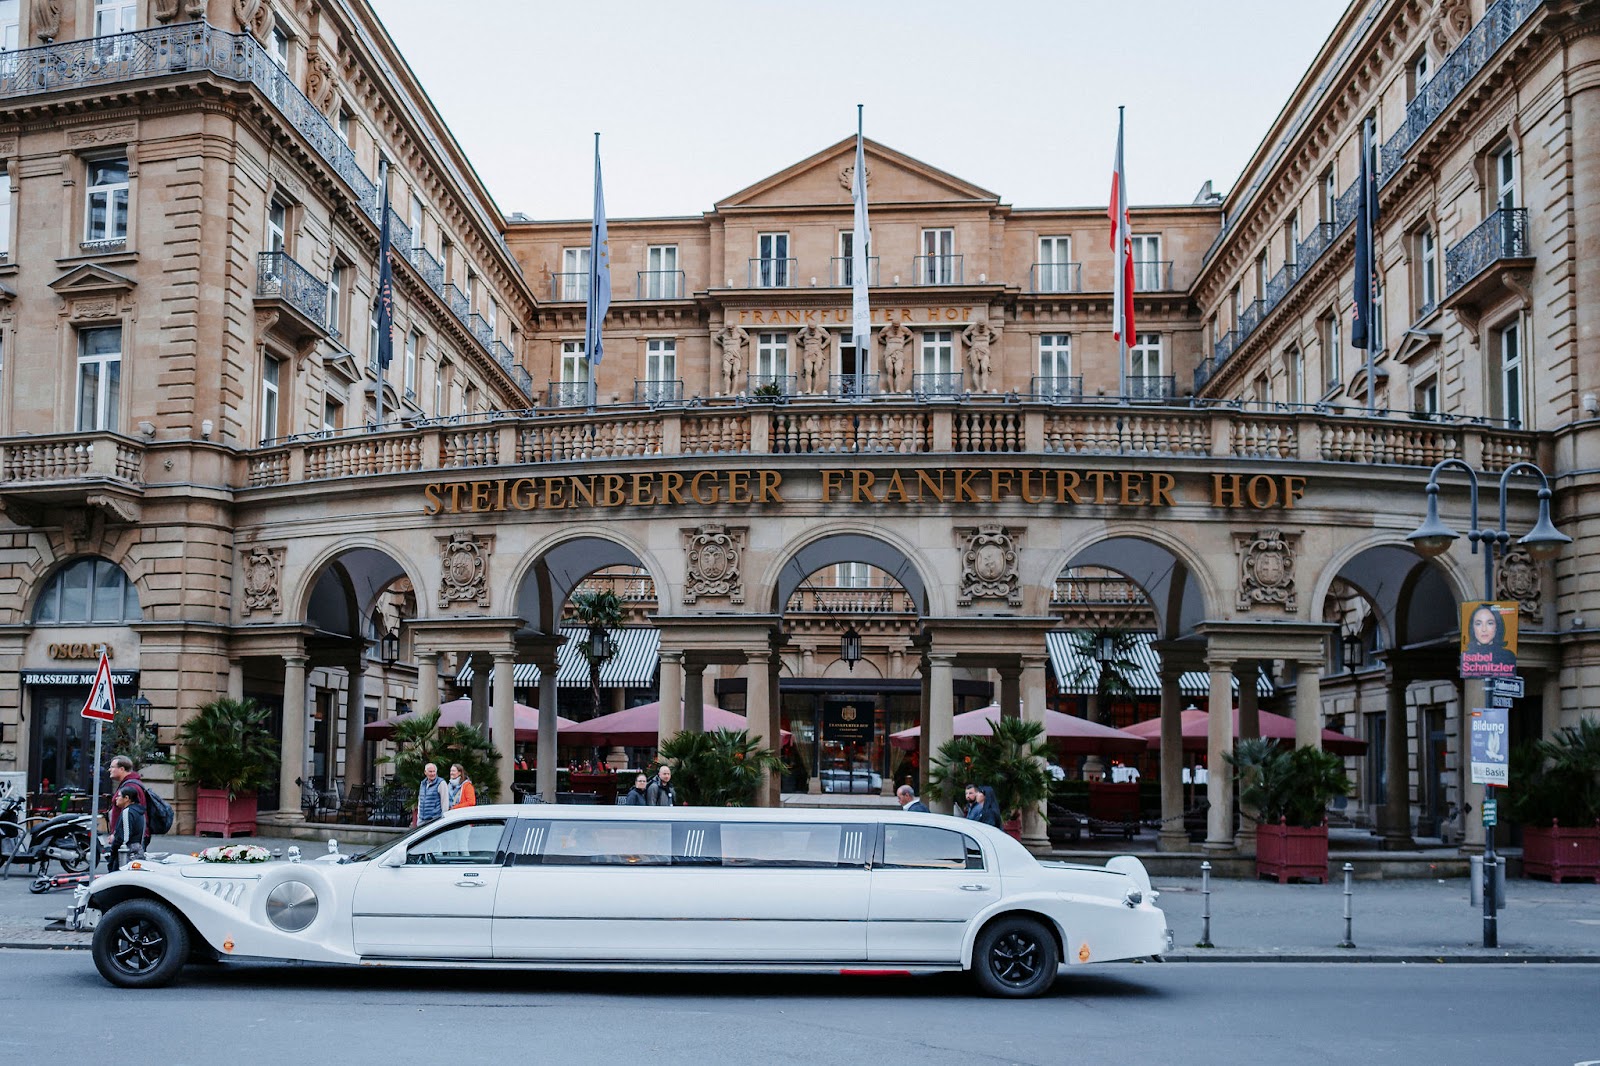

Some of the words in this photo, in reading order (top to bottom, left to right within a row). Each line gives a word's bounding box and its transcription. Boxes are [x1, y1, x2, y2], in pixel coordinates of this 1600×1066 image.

[739, 308, 913, 324] FRANKFUTER
[927, 307, 974, 322] HOF
[423, 470, 786, 516] STEIGENBERGER
[819, 469, 1177, 507] FRANKFURTER
[1211, 473, 1308, 509] HOF
[1462, 652, 1493, 662] Isabel
[1461, 662, 1515, 673] Schnitzler
[25, 674, 78, 685] BRASSERIE
[79, 674, 131, 685] MORNE
[1473, 719, 1505, 735] Bildung
